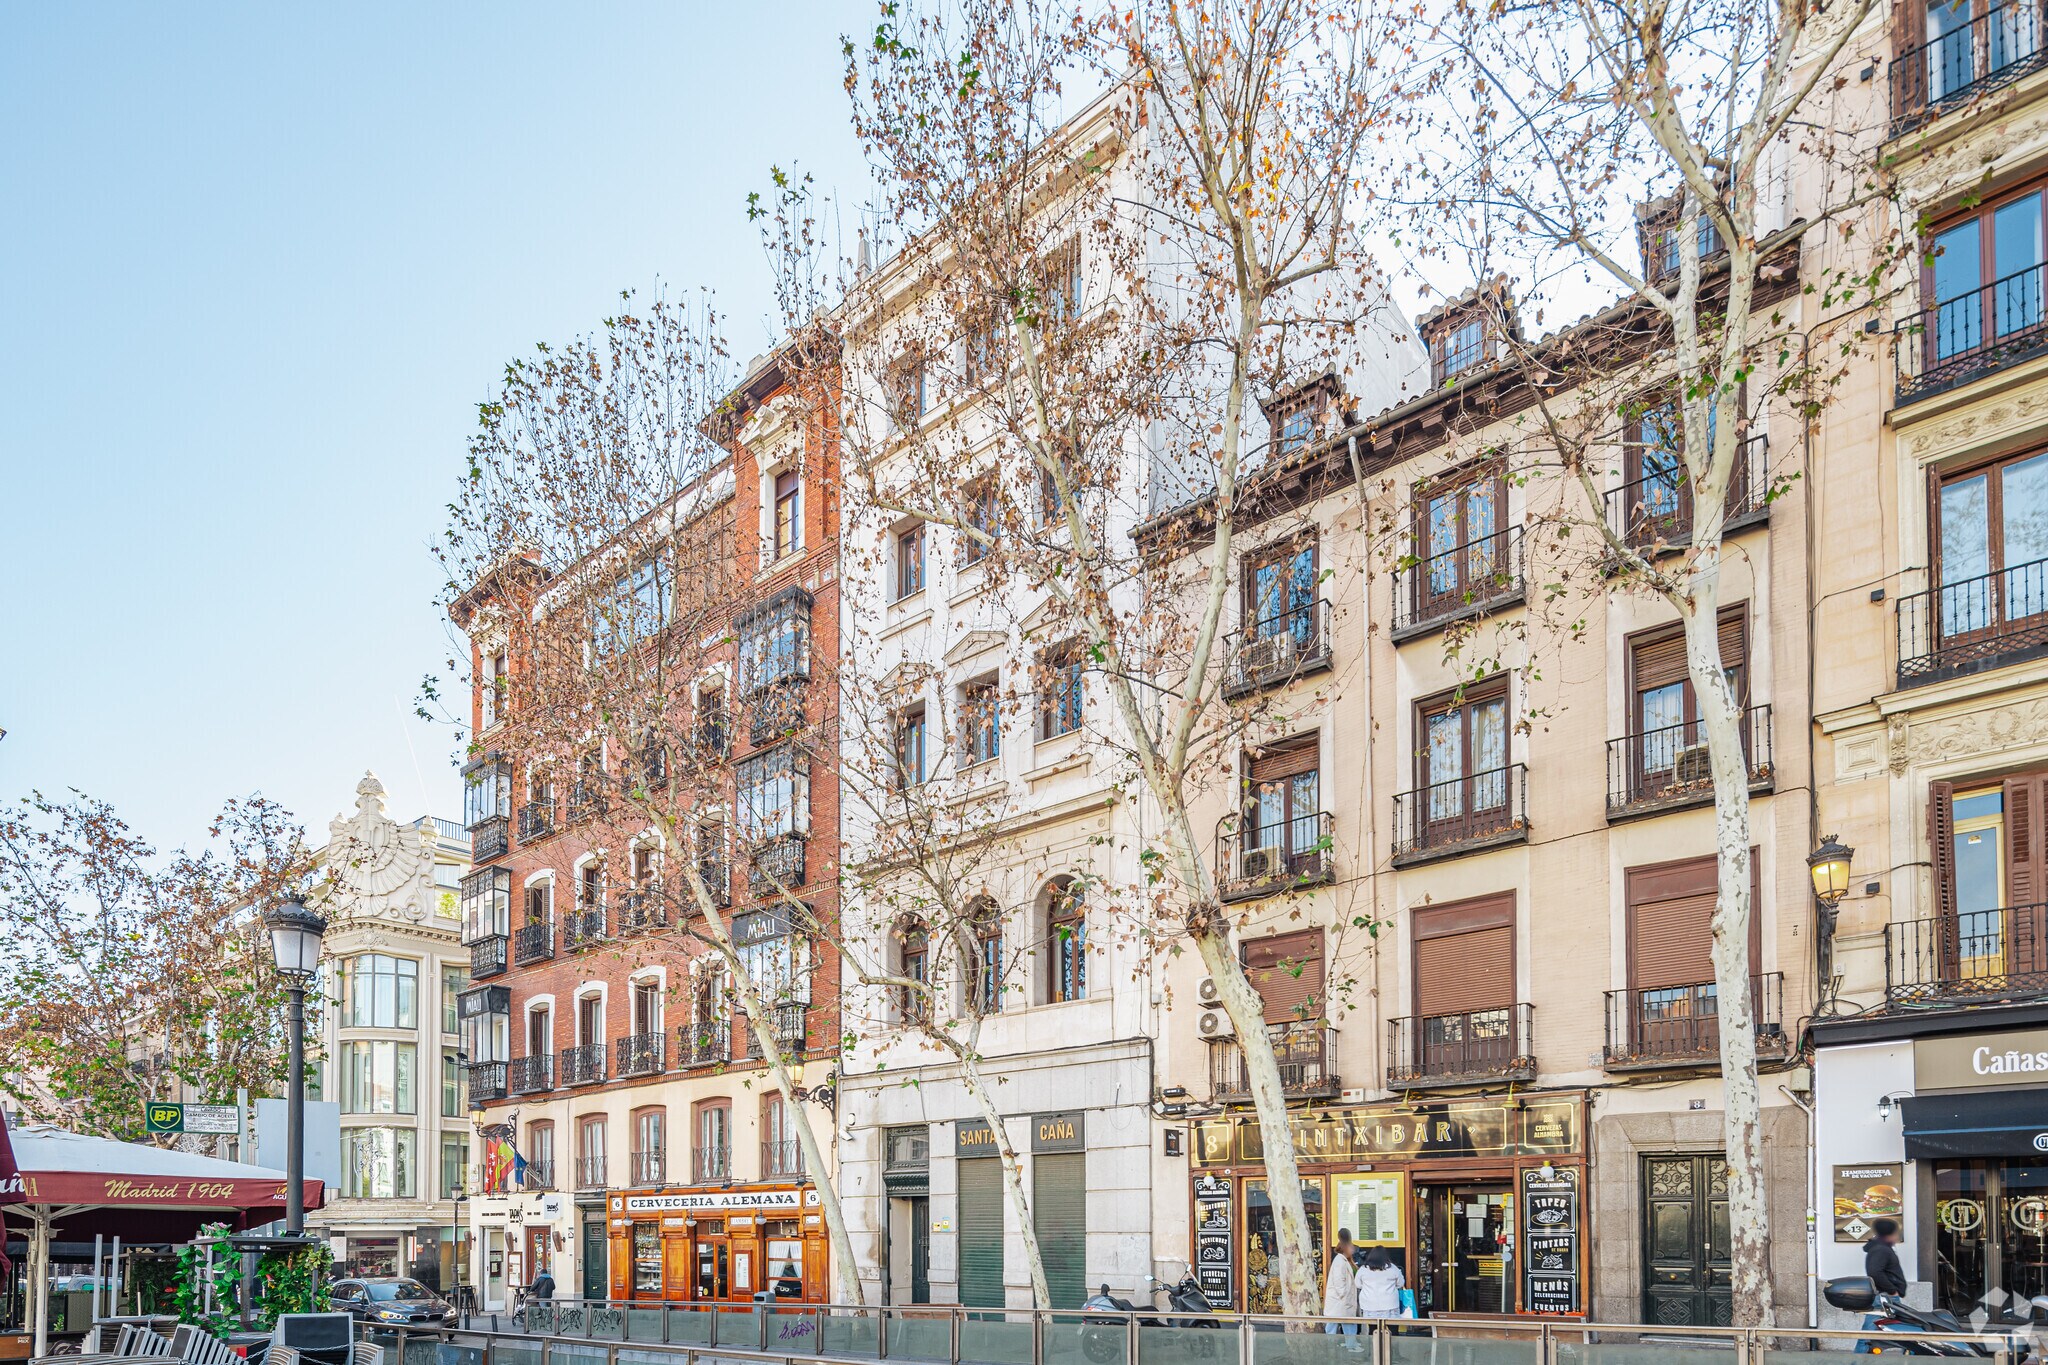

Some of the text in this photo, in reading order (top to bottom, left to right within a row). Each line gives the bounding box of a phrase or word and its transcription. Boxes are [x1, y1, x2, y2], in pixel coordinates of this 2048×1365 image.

[1973, 1046, 2048, 1075] Cañas
[1693, 1100, 1701, 1109] 8
[153, 1109, 178, 1122] BP
[960, 1120, 1075, 1146] SANTA CAÑA
[1535, 1124, 1562, 1132] CERVEZAS
[1206, 1121, 1452, 1154] 8 INTXIBAR
[1534, 1130, 1564, 1139] ALHAMBRA
[1841, 1169, 1892, 1178] HAMBURGUESA
[857, 1176, 862, 1186] 7
[104, 1180, 235, 1199] Madrid 1904
[631, 1193, 796, 1208] CERVECERIA ALEMANA
[810, 1194, 816, 1202] 6
[1533, 1238, 1569, 1250] PINTXOS
[1533, 1279, 1569, 1292] MENÚS
[1534, 1302, 1569, 1312] EVENTOS
